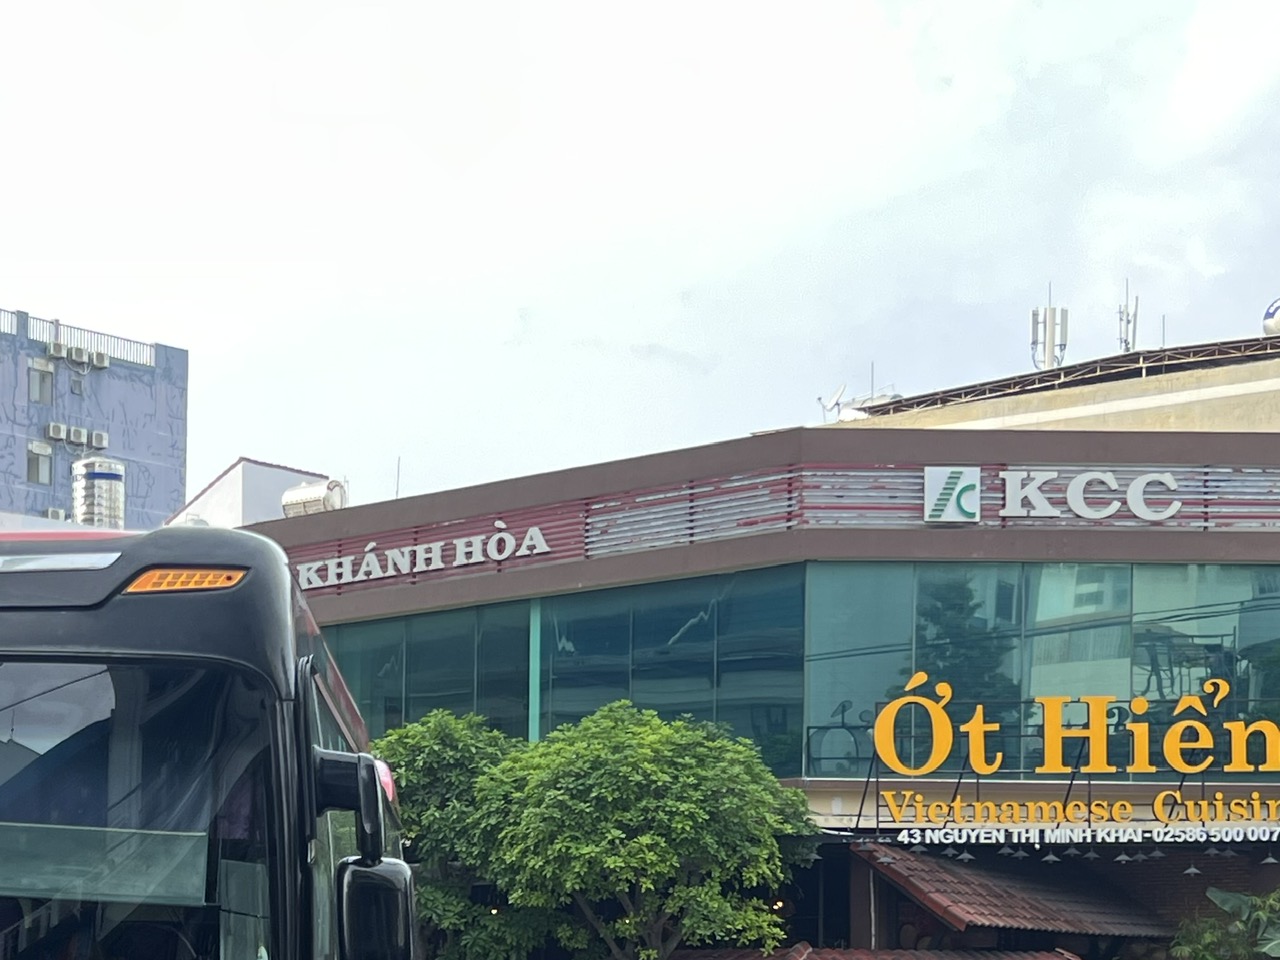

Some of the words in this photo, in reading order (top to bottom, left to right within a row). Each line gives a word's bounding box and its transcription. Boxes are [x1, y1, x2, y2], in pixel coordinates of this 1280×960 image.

[998, 470, 1182, 521] KCC
[296, 541, 446, 591] KHÁNH
[452, 520, 552, 567] HÒA
[873, 671, 1003, 776] Ớt
[1034, 678, 1280, 774] Hiển
[880, 791, 1133, 824] Vietnamese
[896, 828, 922, 844] 43
[1044, 828, 1092, 844] MINH
[1209, 827, 1244, 843] 500
